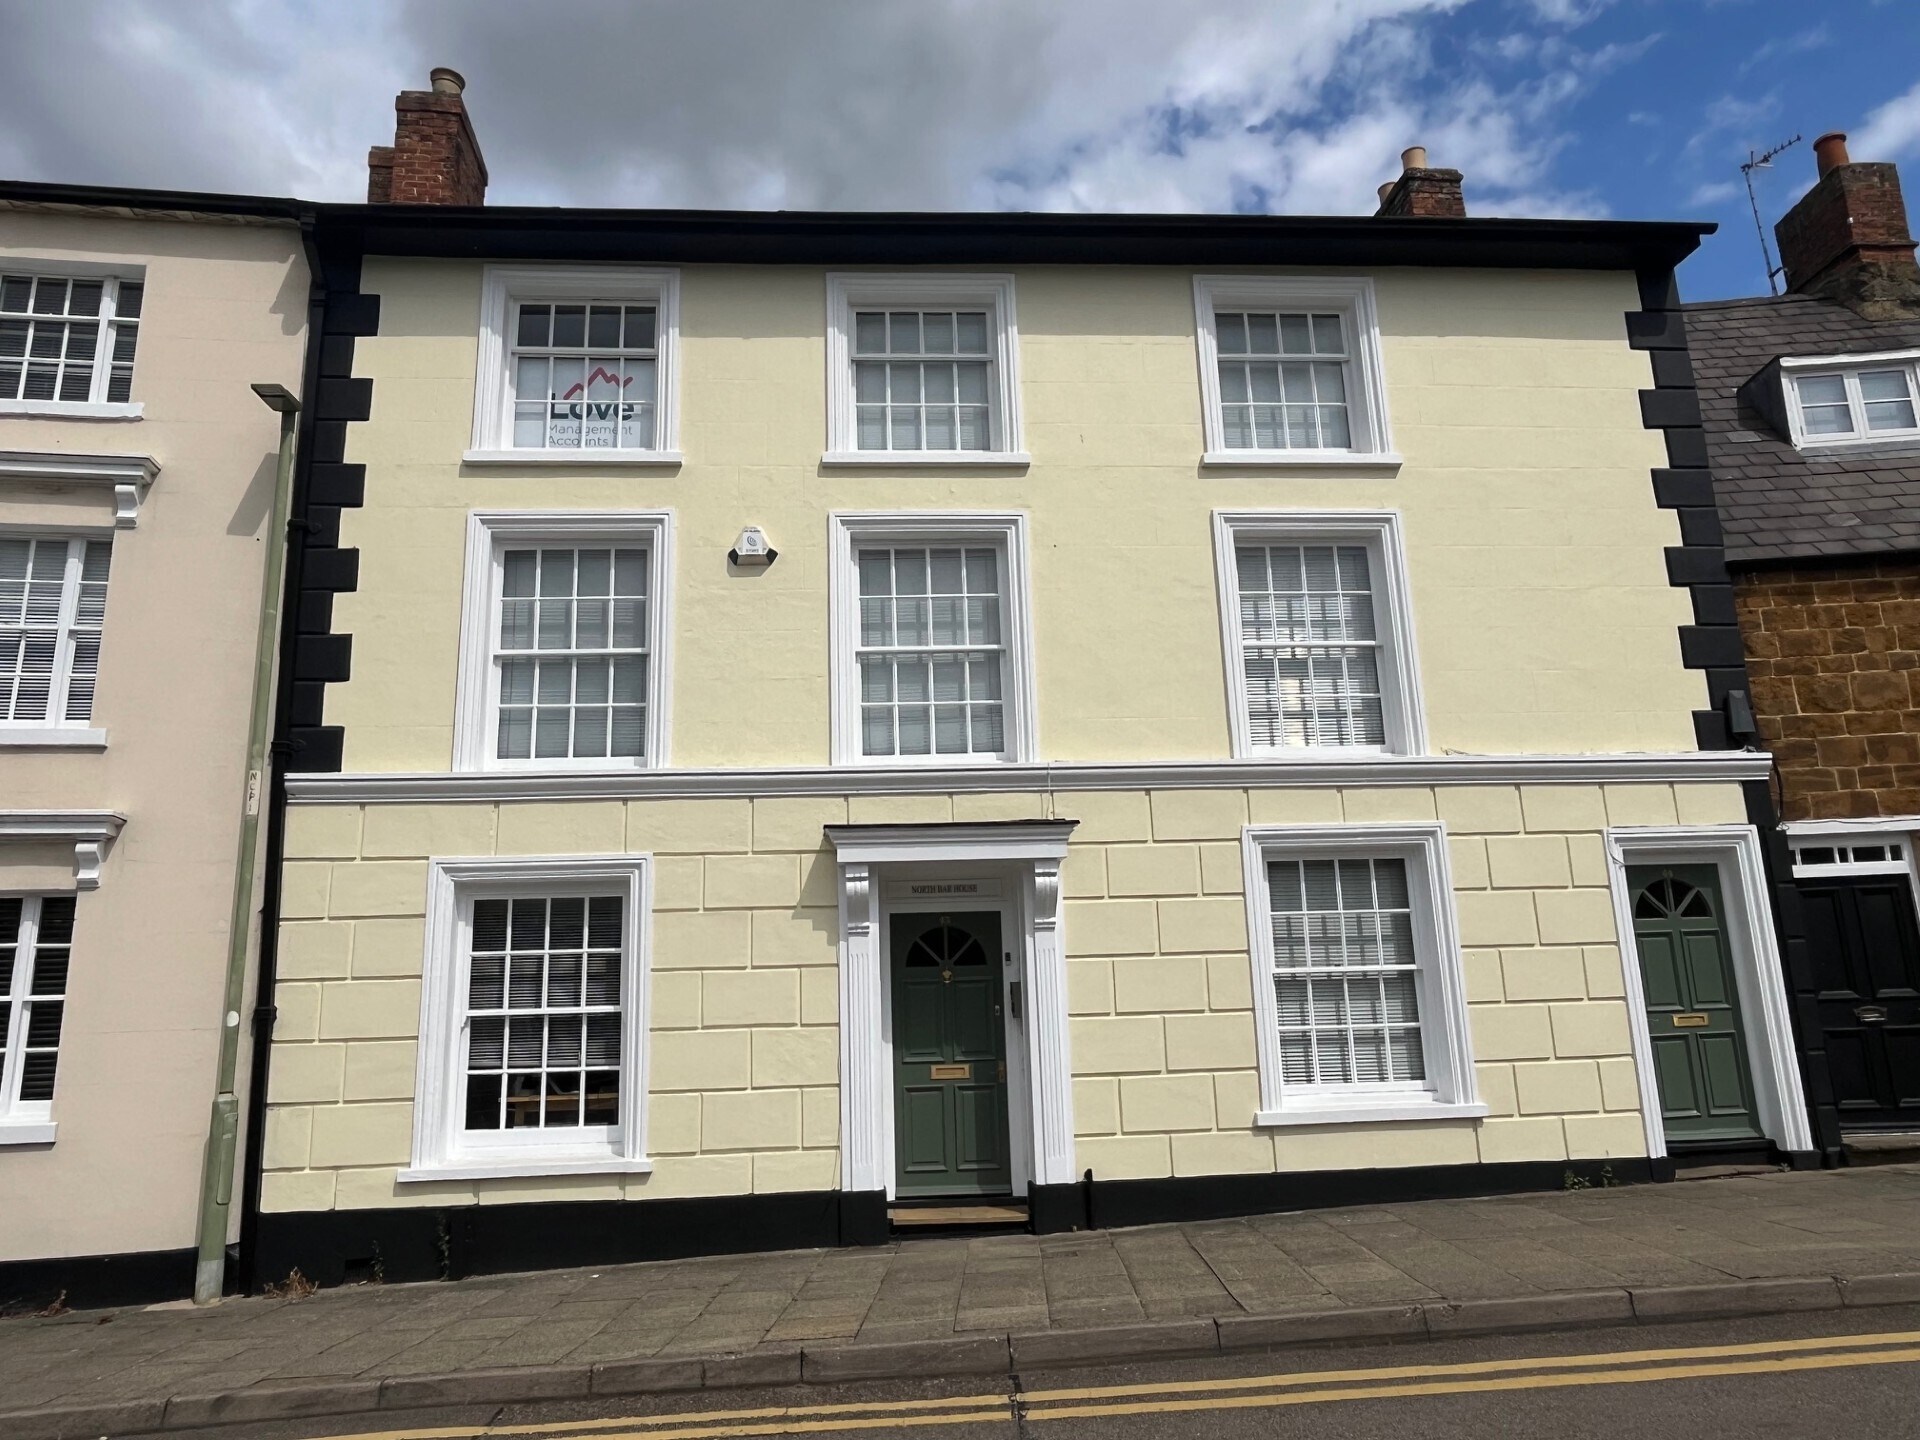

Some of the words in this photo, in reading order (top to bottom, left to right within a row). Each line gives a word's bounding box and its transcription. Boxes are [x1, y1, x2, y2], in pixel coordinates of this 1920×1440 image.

[550, 393, 635, 421] Love
[548, 435, 609, 447] Acconts
[911, 885, 936, 894] NORTH
[937, 884, 952, 893] BAR
[953, 883, 977, 893] HOUSE
